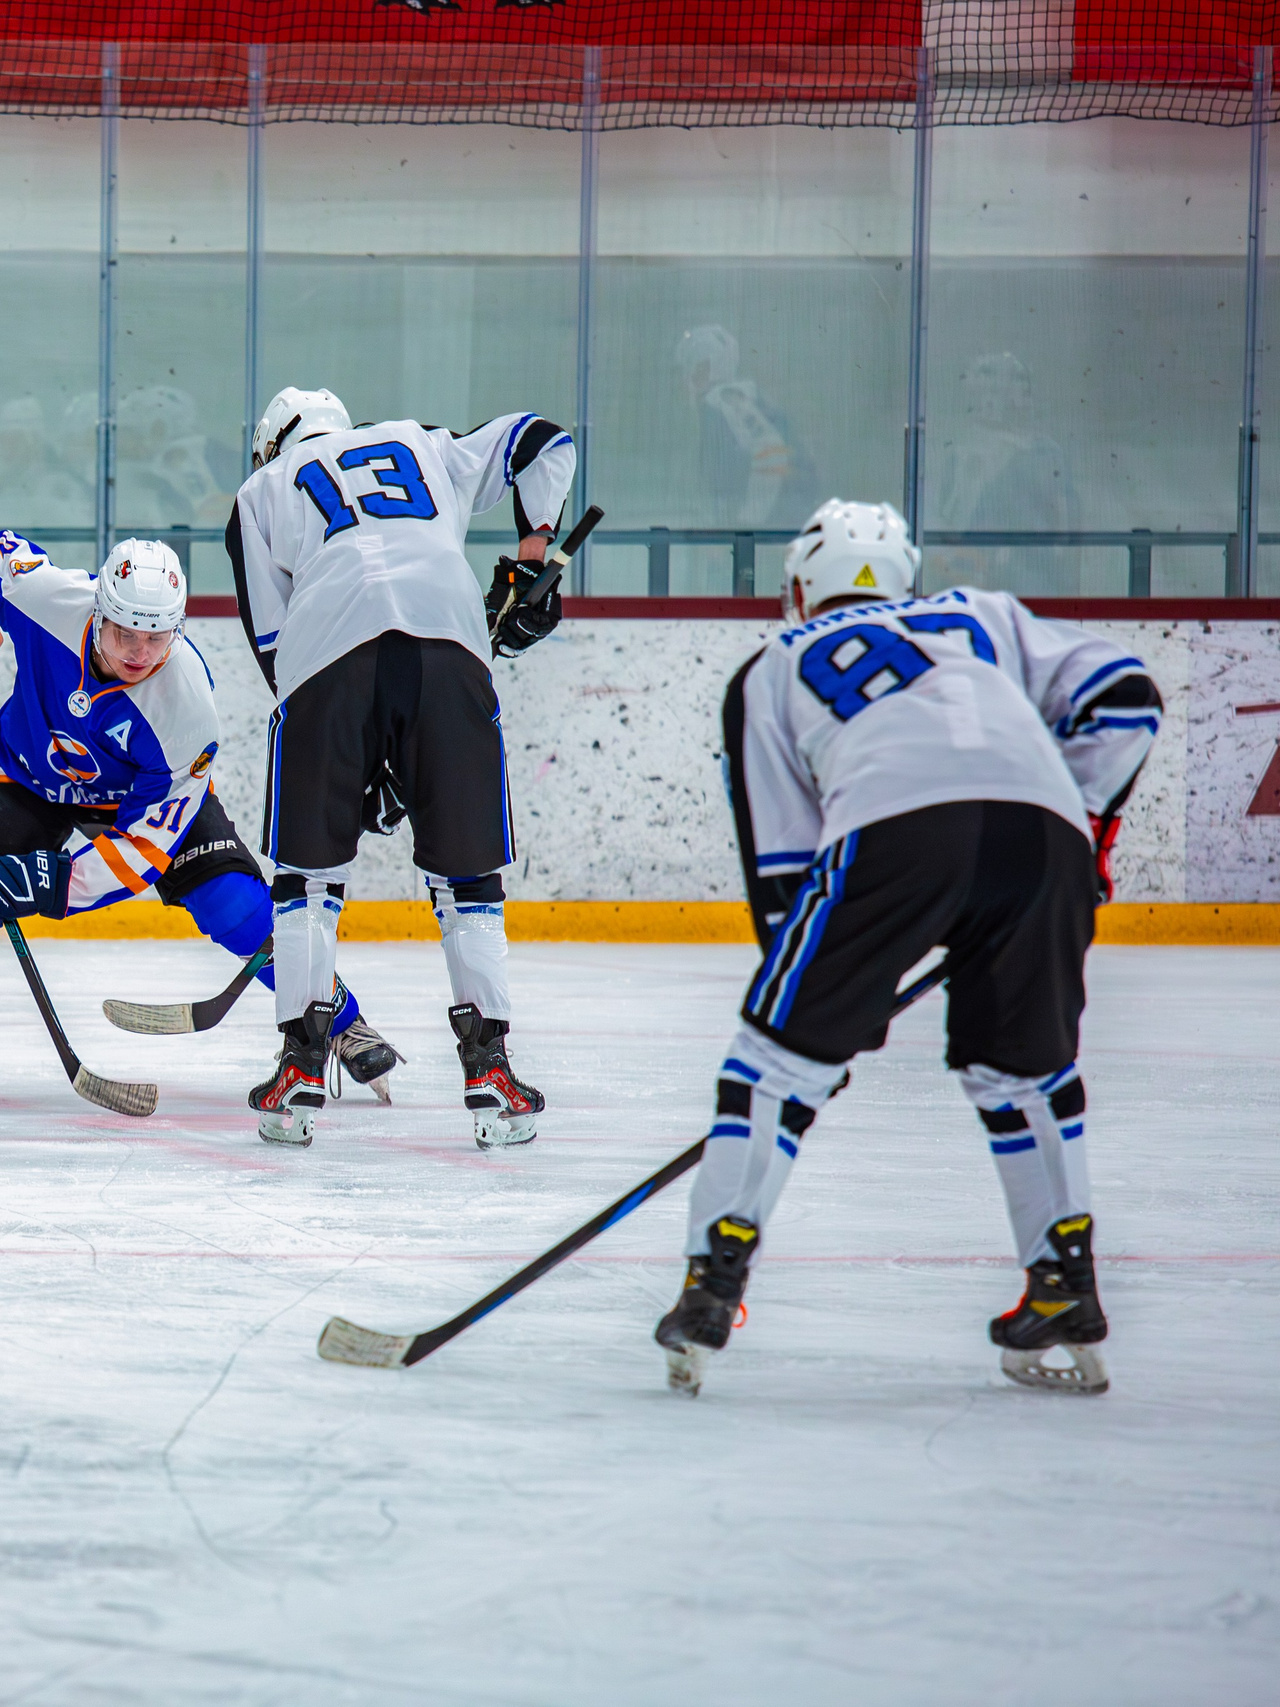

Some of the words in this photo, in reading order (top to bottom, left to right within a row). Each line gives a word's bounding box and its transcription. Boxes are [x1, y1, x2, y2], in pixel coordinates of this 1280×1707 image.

[293, 439, 440, 543] 13
[131, 610, 161, 619] BAUER
[797, 612, 998, 724] 87
[104, 719, 133, 752] A
[173, 839, 238, 870] BAUER
[313, 1005, 333, 1013] CCM
[452, 1007, 472, 1016] CCM
[265, 1067, 296, 1109] CCM
[493, 1071, 528, 1111] CCM
